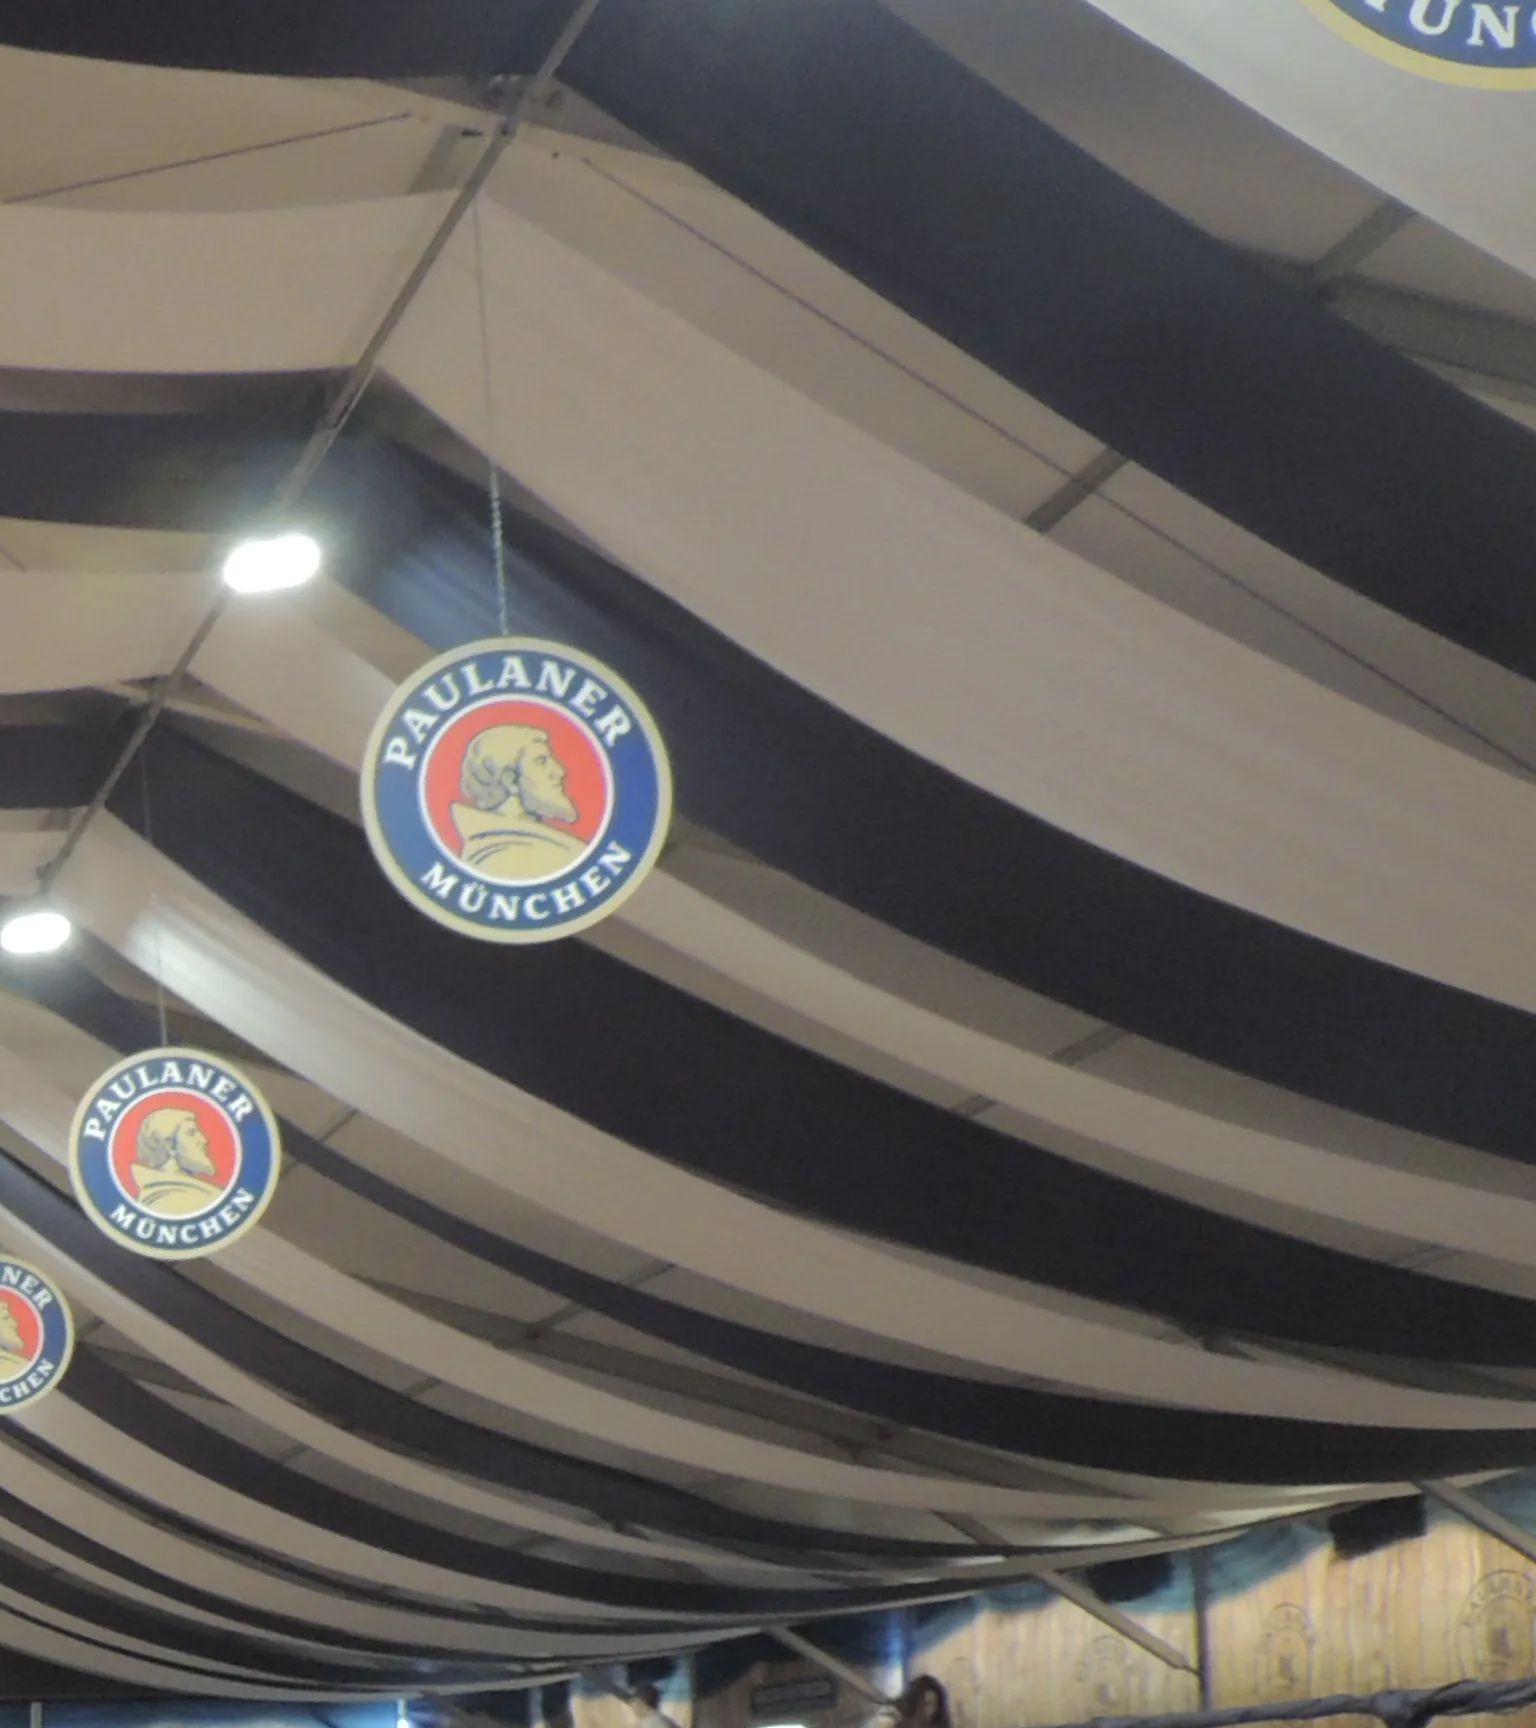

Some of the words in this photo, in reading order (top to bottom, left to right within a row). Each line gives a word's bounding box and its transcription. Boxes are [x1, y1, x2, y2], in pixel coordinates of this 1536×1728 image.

[383, 656, 632, 770] PAULANER
[420, 841, 633, 921] MÜNCHEN
[83, 1061, 254, 1141] PAULANER
[110, 1188, 255, 1244] MÜNCHEN
